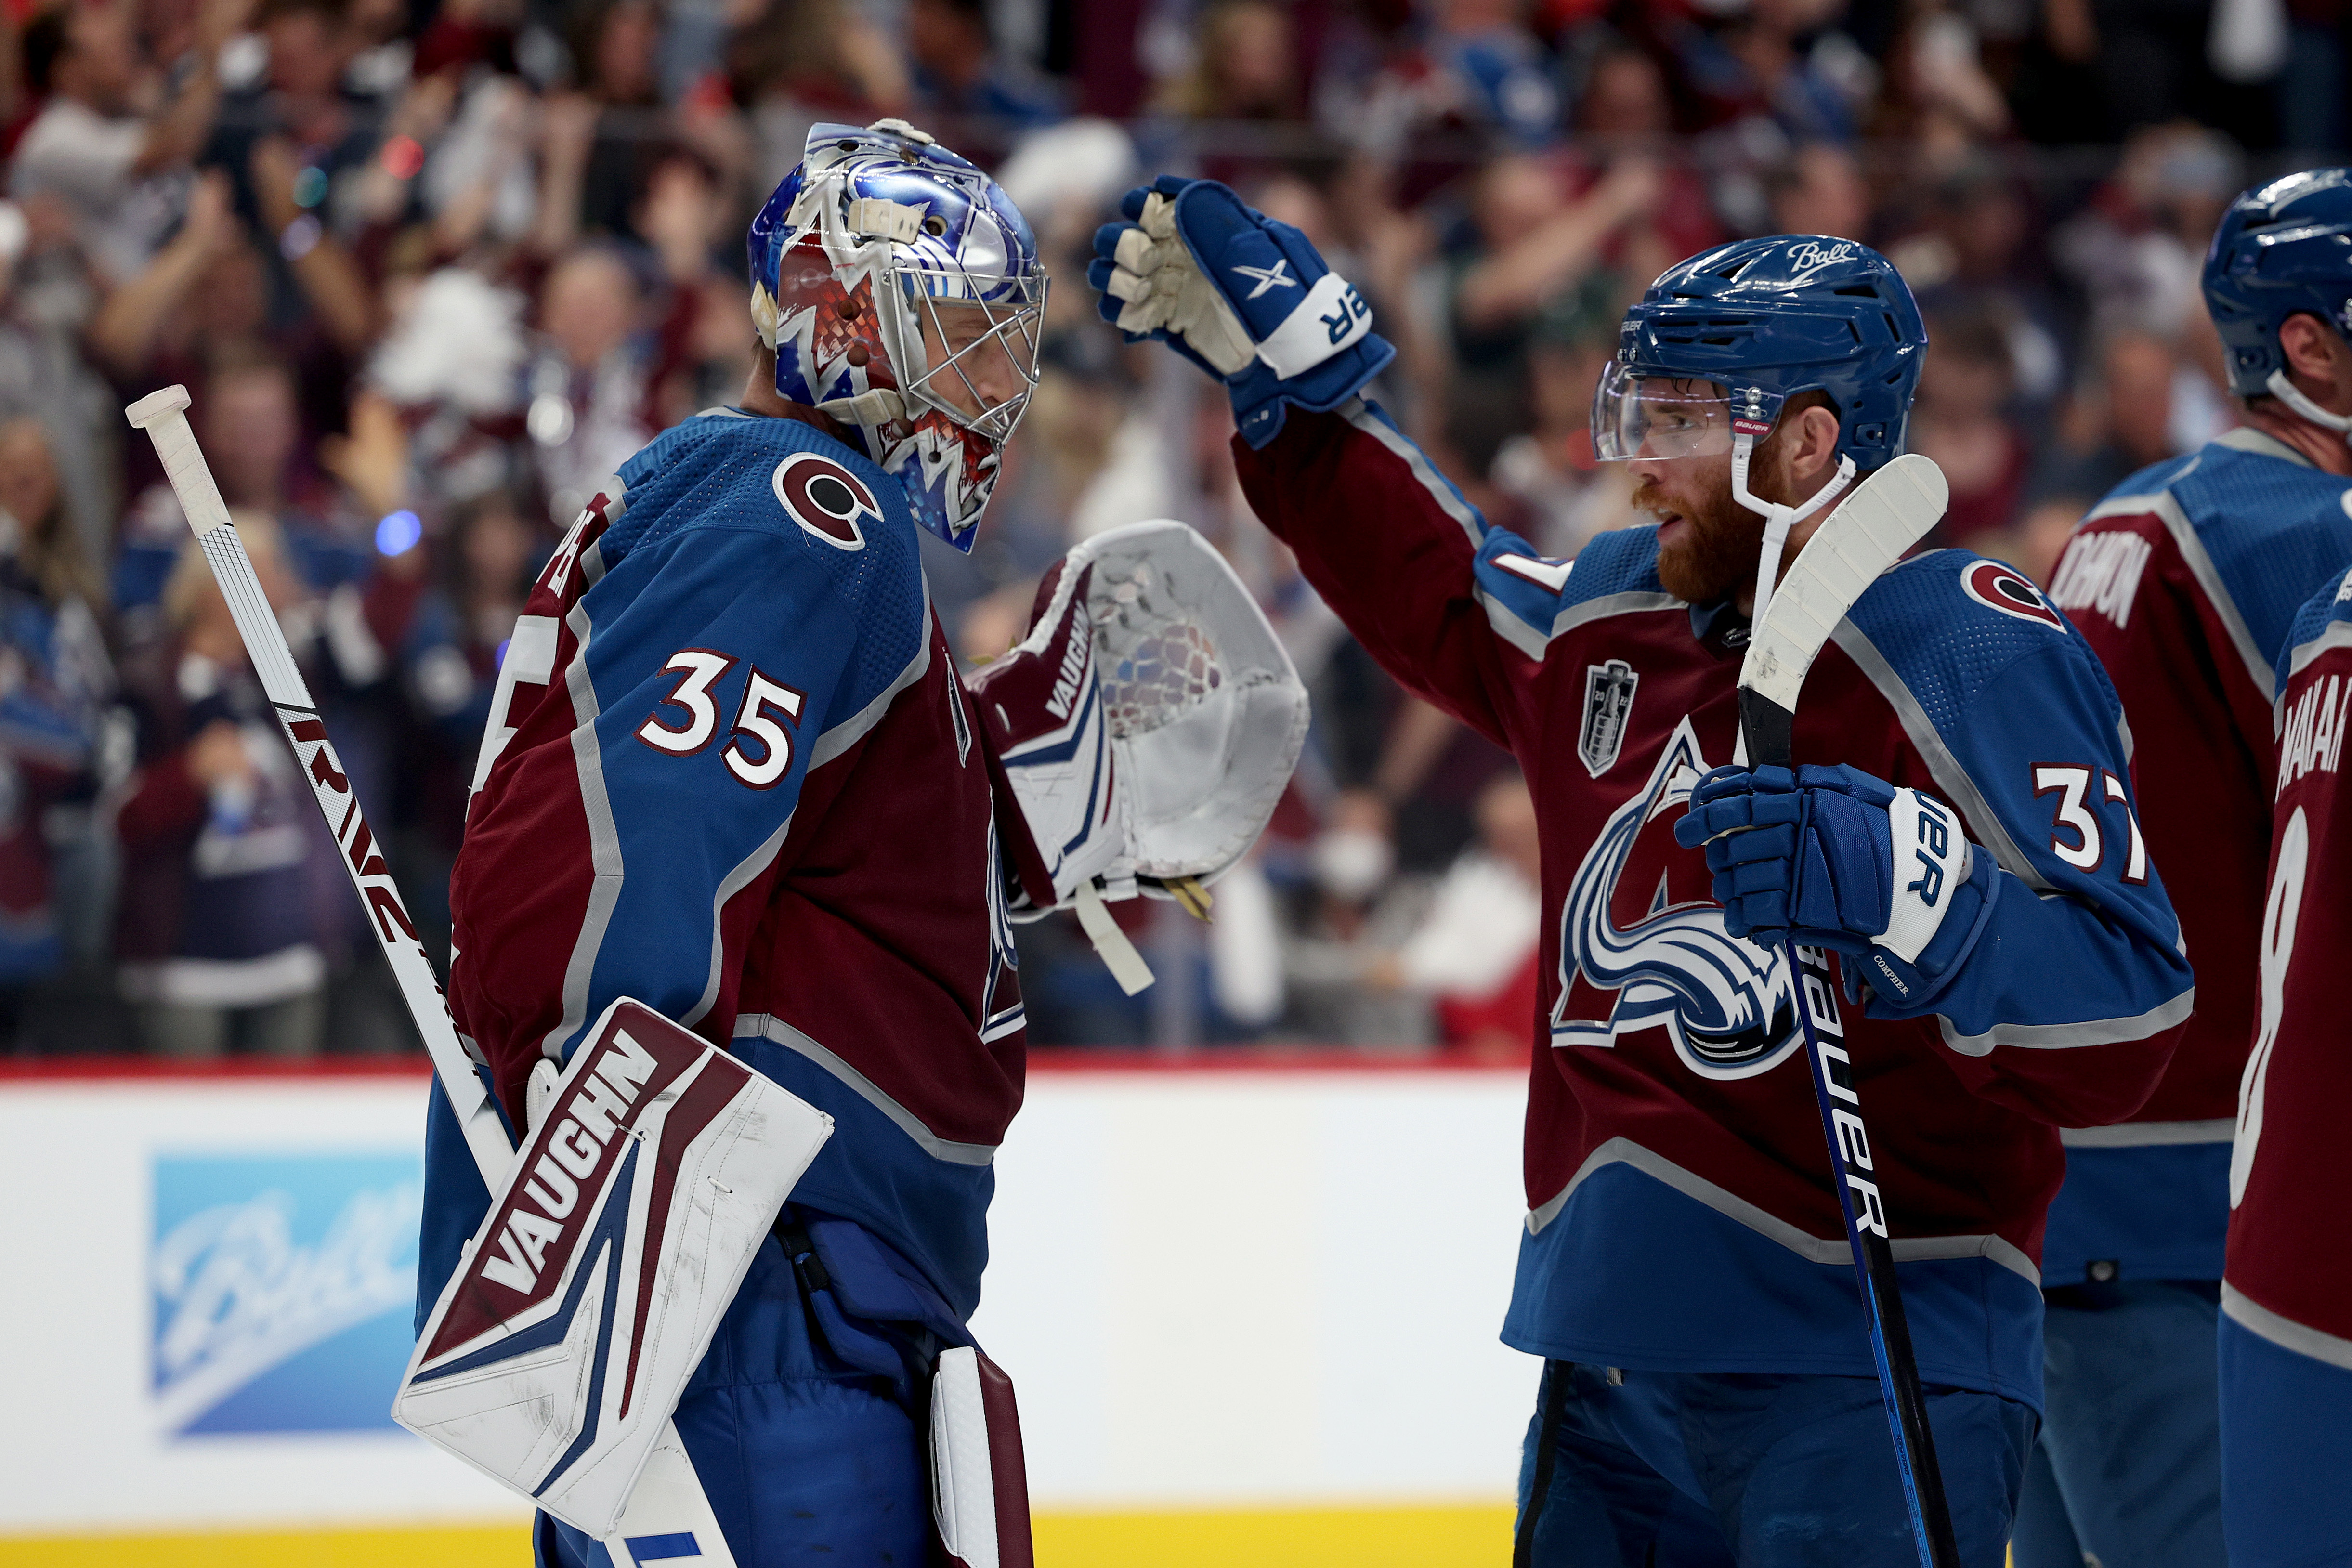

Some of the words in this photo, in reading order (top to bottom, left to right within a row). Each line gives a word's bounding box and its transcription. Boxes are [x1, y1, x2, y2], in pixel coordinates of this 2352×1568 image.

[1787, 241, 1858, 279] Ball
[632, 647, 808, 791] 35
[1045, 599, 1091, 720] VAUGHN
[2029, 761, 2150, 887] 37
[1874, 955, 1909, 998] COMPHER
[480, 1027, 659, 1296] VAUGHN
